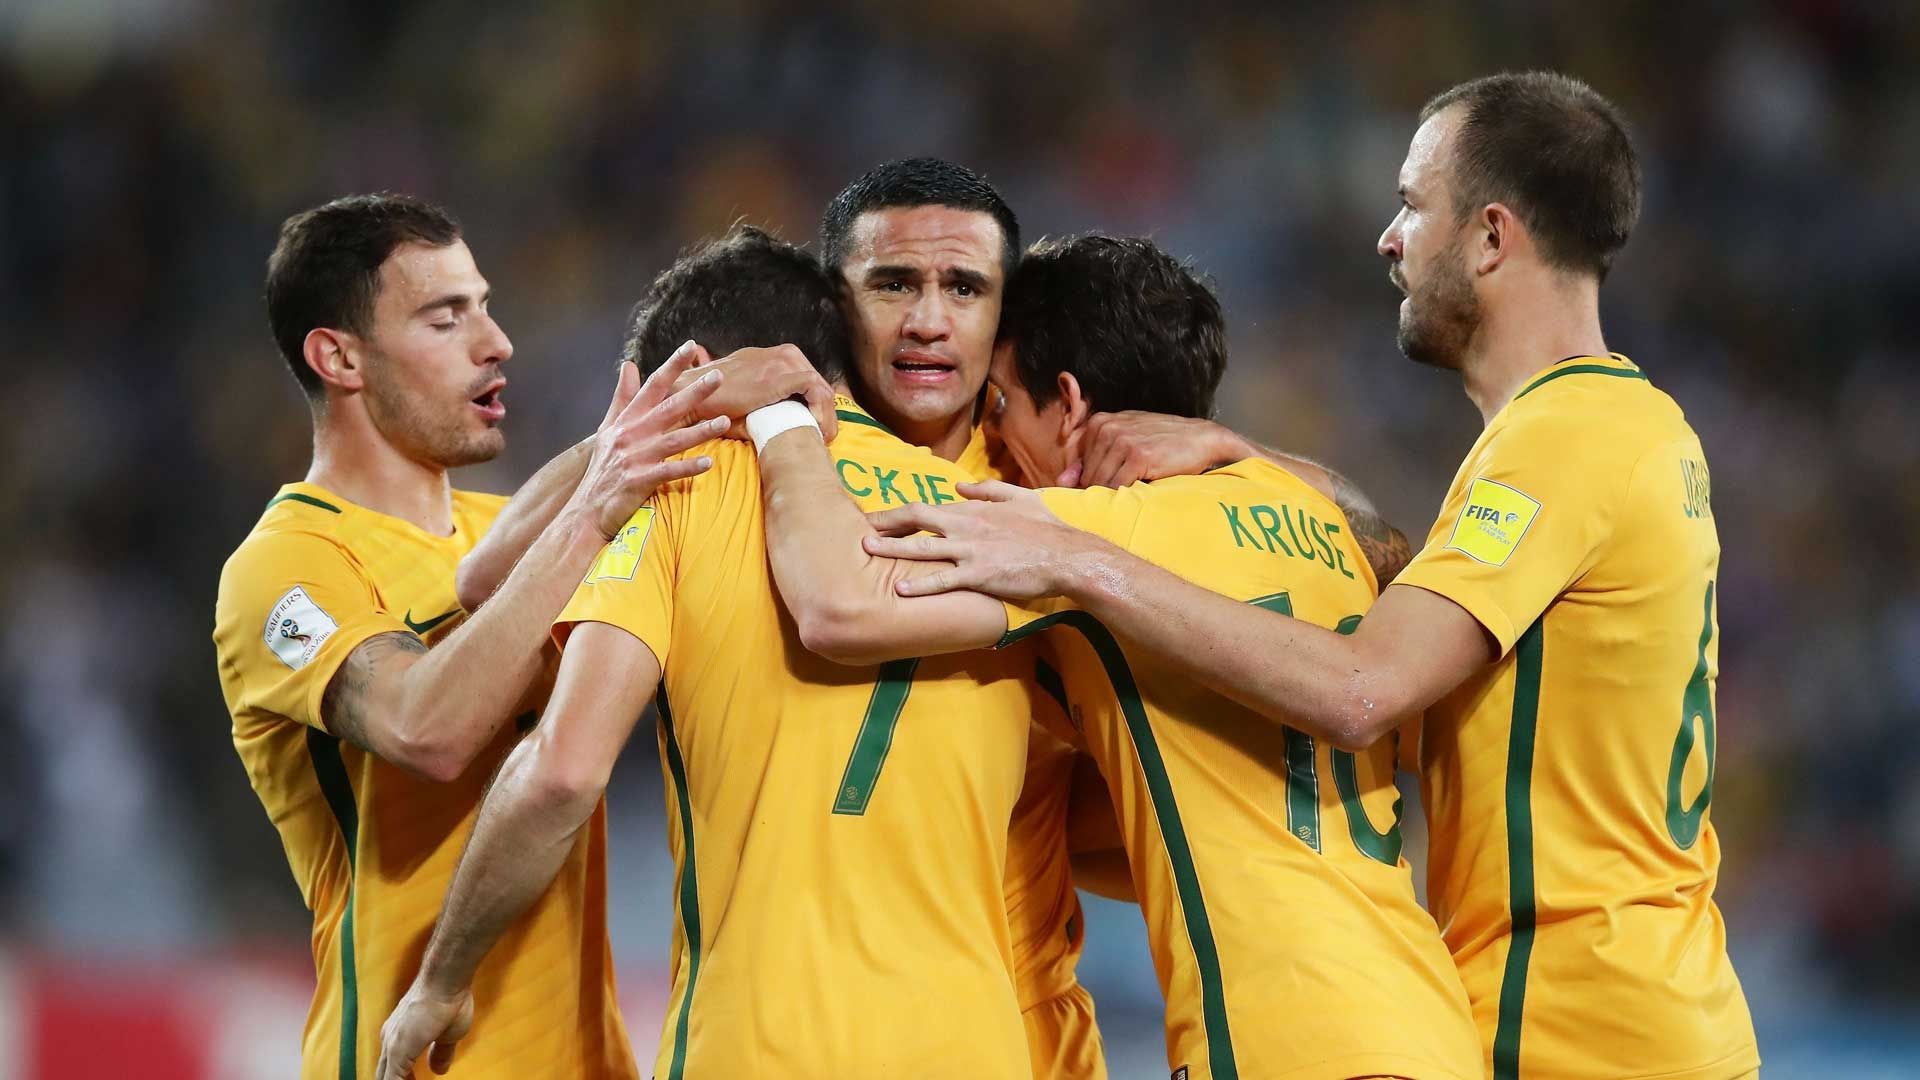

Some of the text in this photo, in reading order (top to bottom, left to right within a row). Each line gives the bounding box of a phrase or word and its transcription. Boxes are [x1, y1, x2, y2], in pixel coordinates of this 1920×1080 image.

[836, 459, 955, 505] CKIE
[1218, 501, 1355, 580] KRUSE
[1466, 504, 1501, 526] FIFA
[1666, 580, 1715, 850] 6
